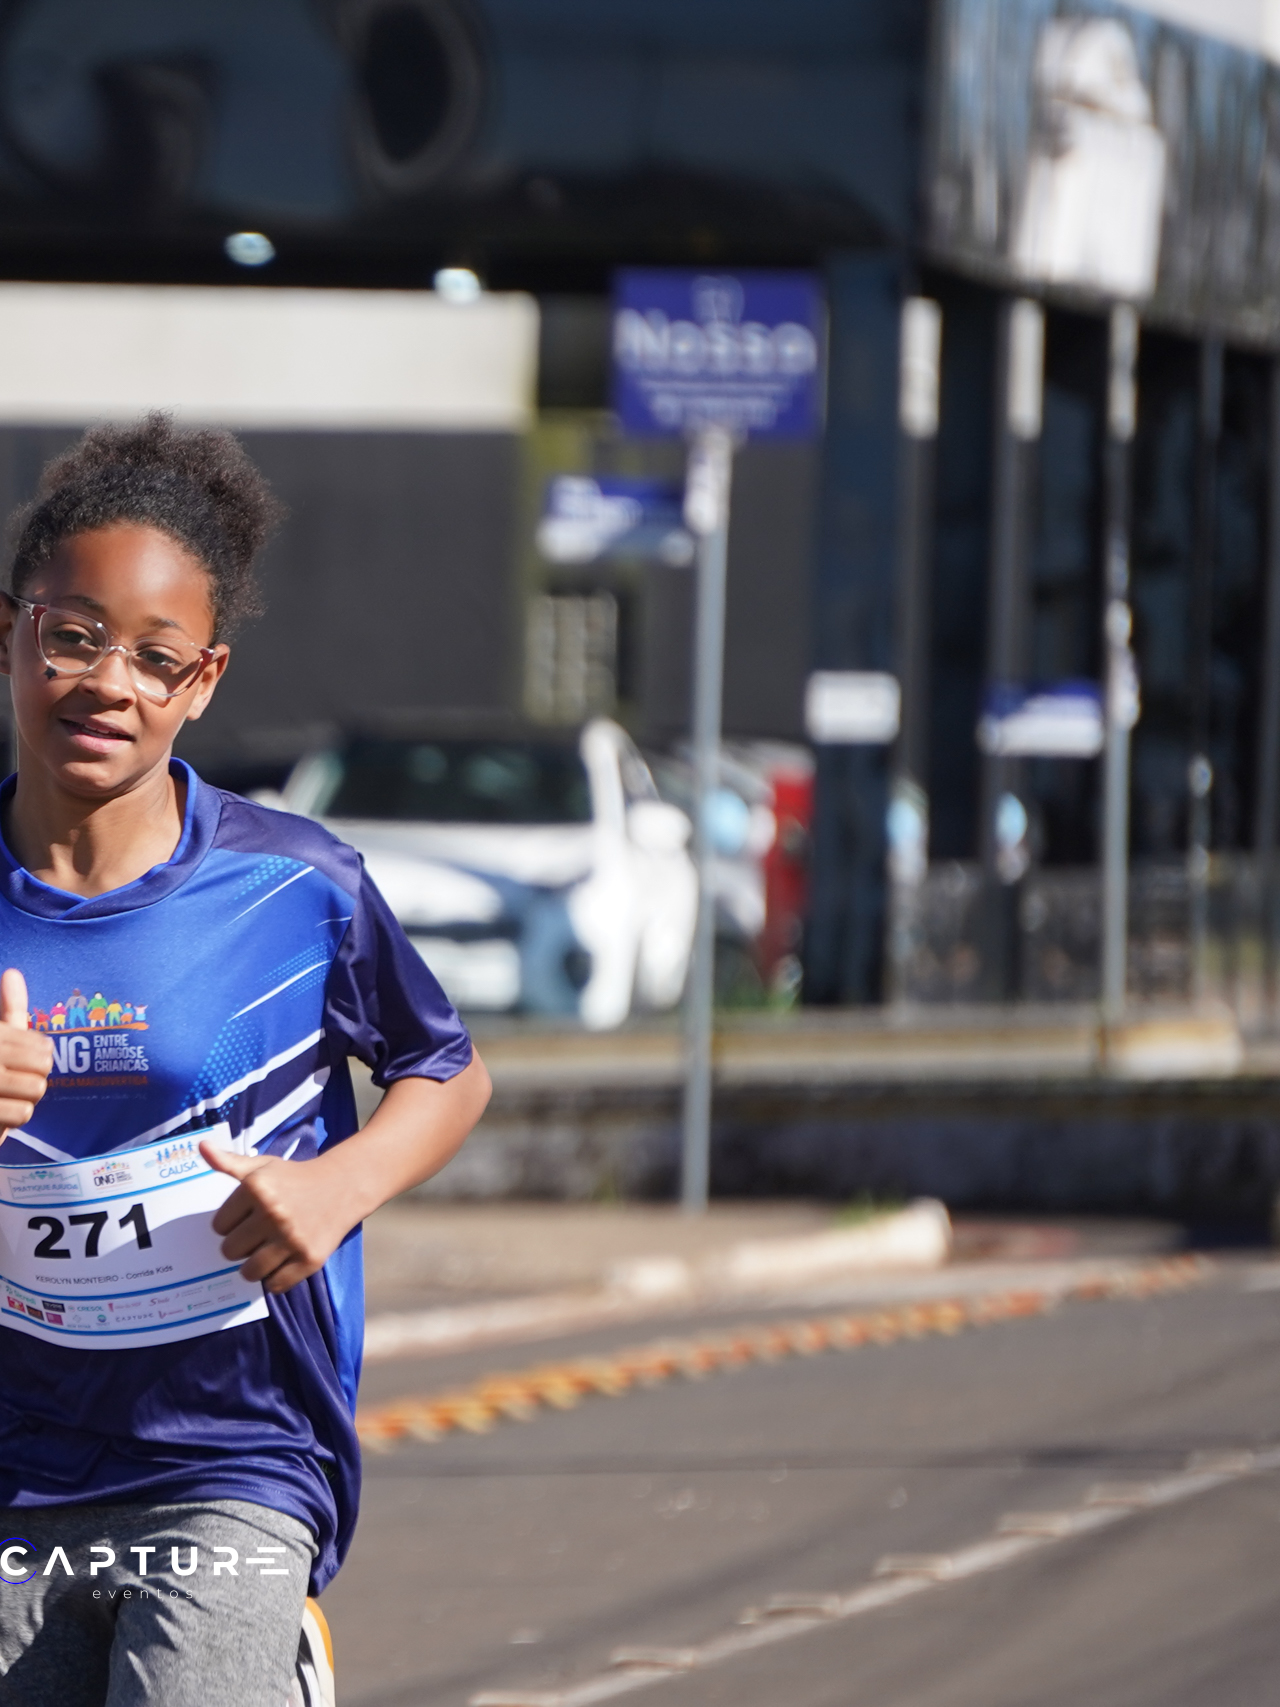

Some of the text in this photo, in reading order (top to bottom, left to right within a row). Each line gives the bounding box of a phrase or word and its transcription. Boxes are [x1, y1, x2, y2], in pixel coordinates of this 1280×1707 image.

[93, 1034, 129, 1048] ENTRE
[48, 1036, 91, 1074] NG
[159, 1160, 199, 1178] CAUSA
[94, 1173, 115, 1187] ONG
[27, 1202, 153, 1260] 271
[35, 1275, 71, 1285] KEROLYN
[73, 1275, 119, 1285] MONTEIRO
[125, 1270, 154, 1281] Corrida
[156, 1265, 174, 1274] Kids
